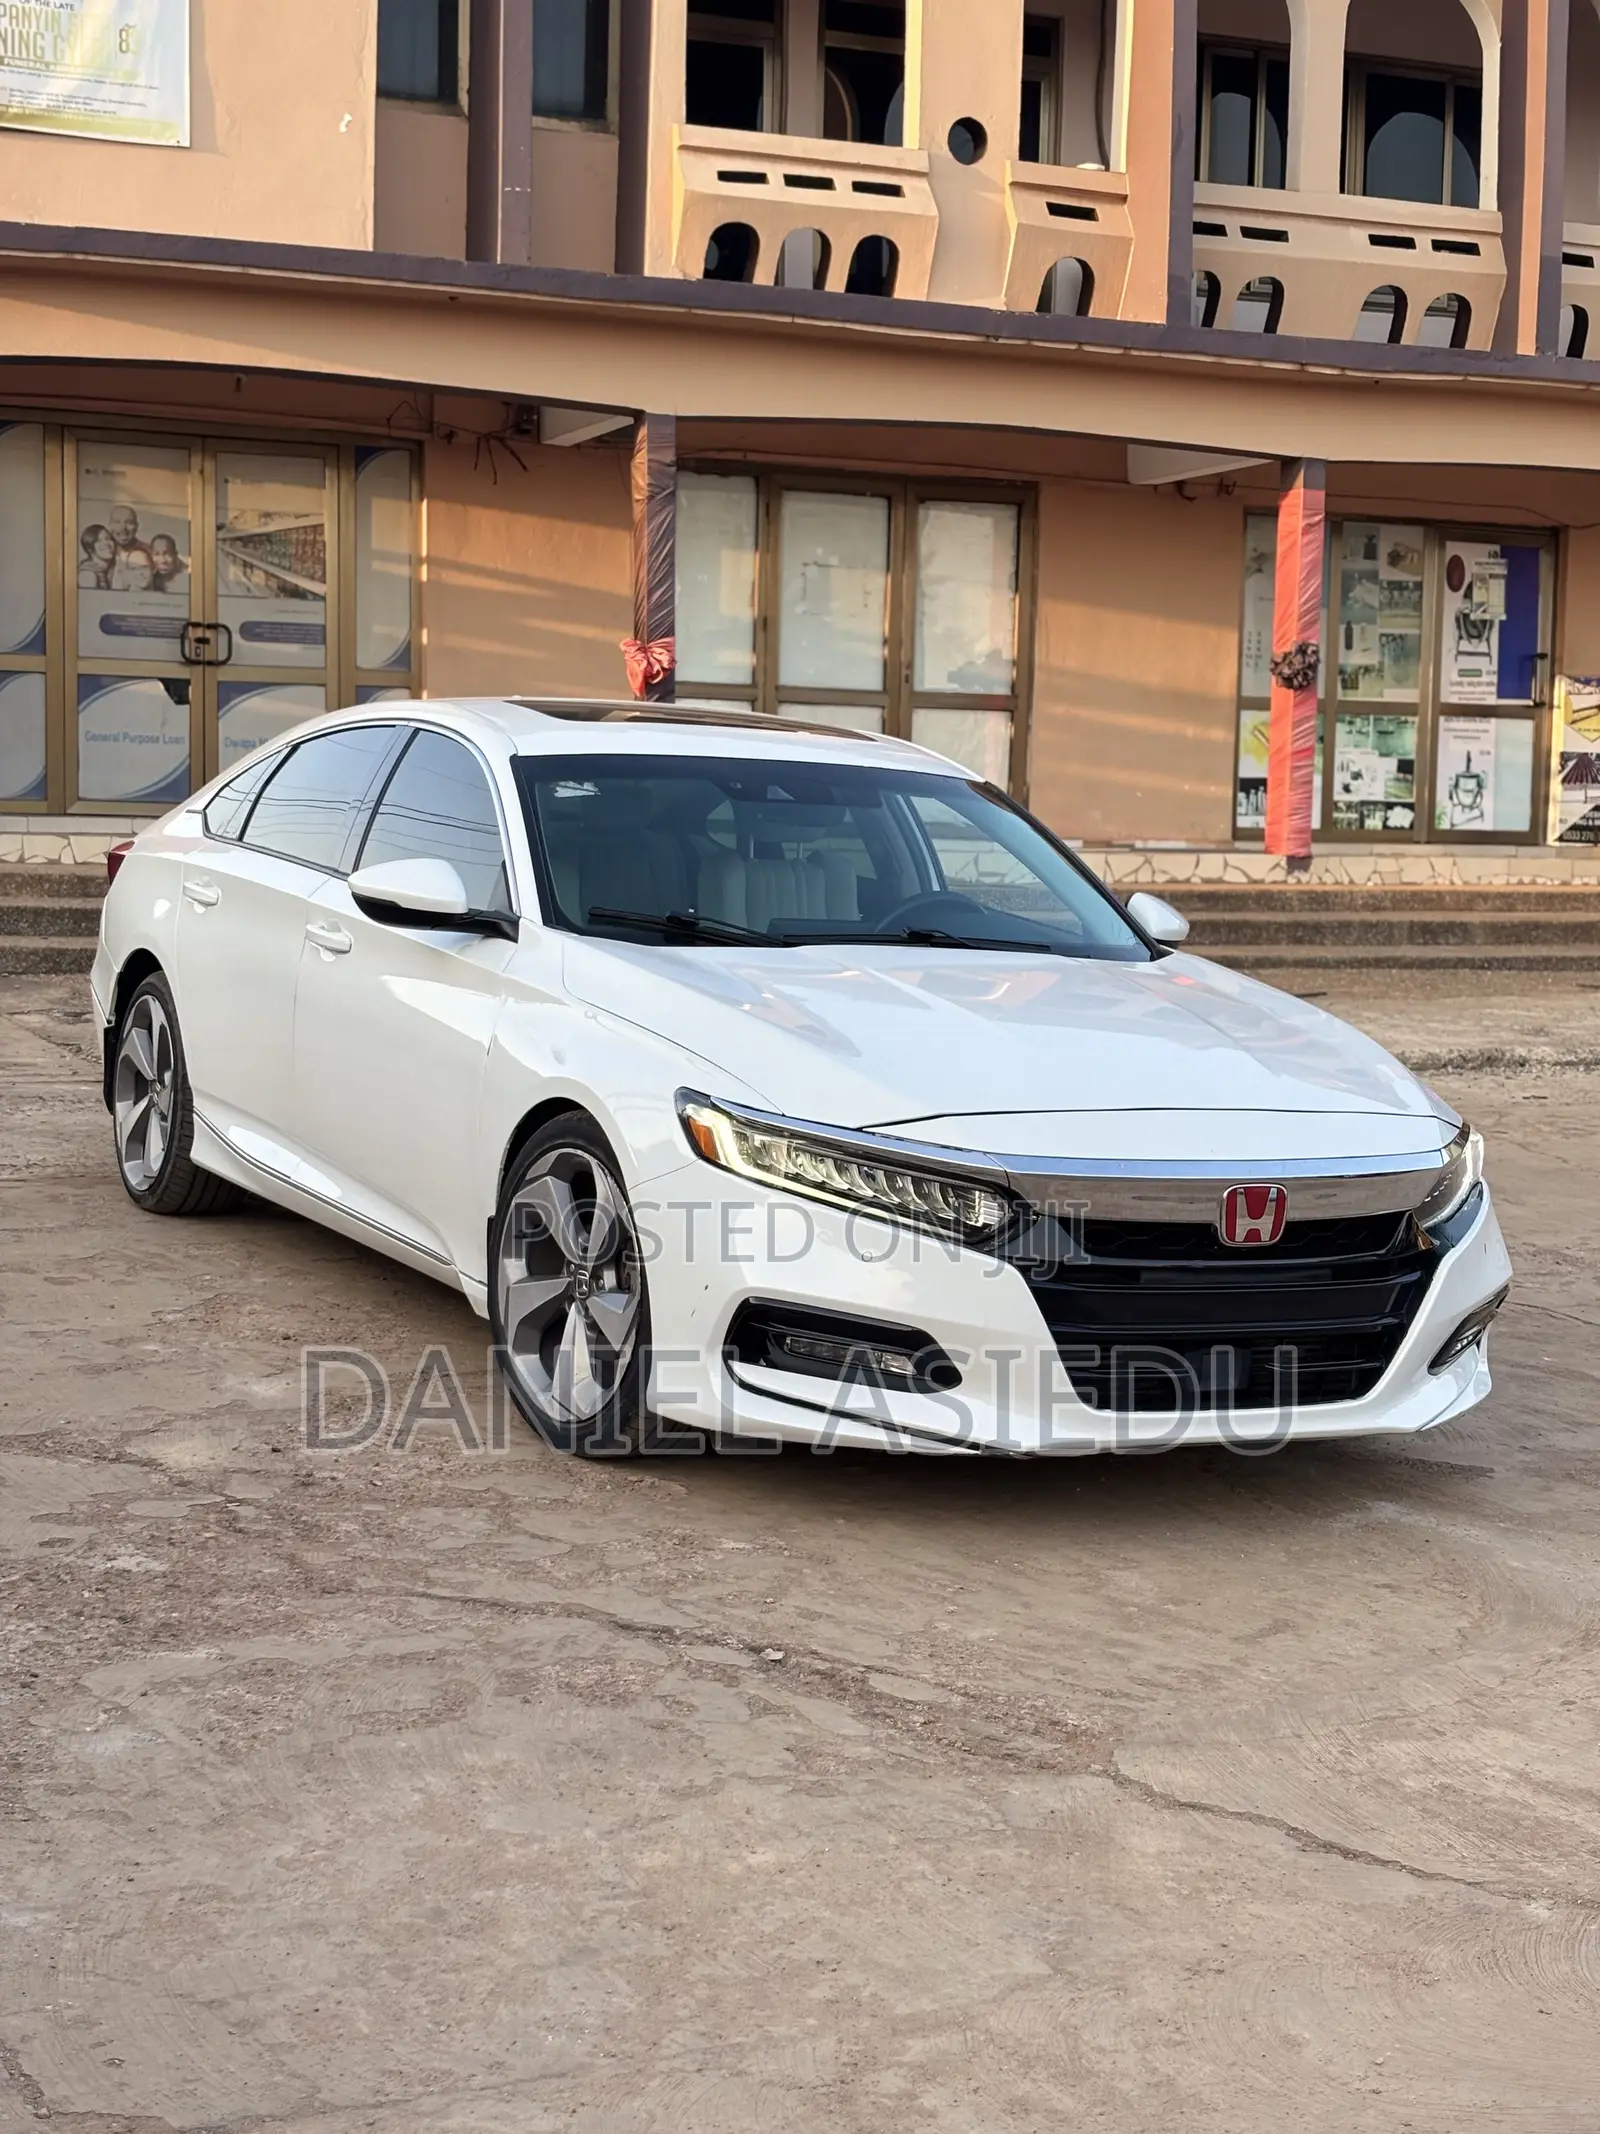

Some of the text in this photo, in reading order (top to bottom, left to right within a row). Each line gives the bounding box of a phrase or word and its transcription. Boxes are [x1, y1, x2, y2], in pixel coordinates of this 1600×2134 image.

[35, 0, 51, 8] THE
[53, 1, 75, 11] LATE
[4, 58, 47, 71] FUNERAL
[84, 730, 186, 746] General Purpose Loan
